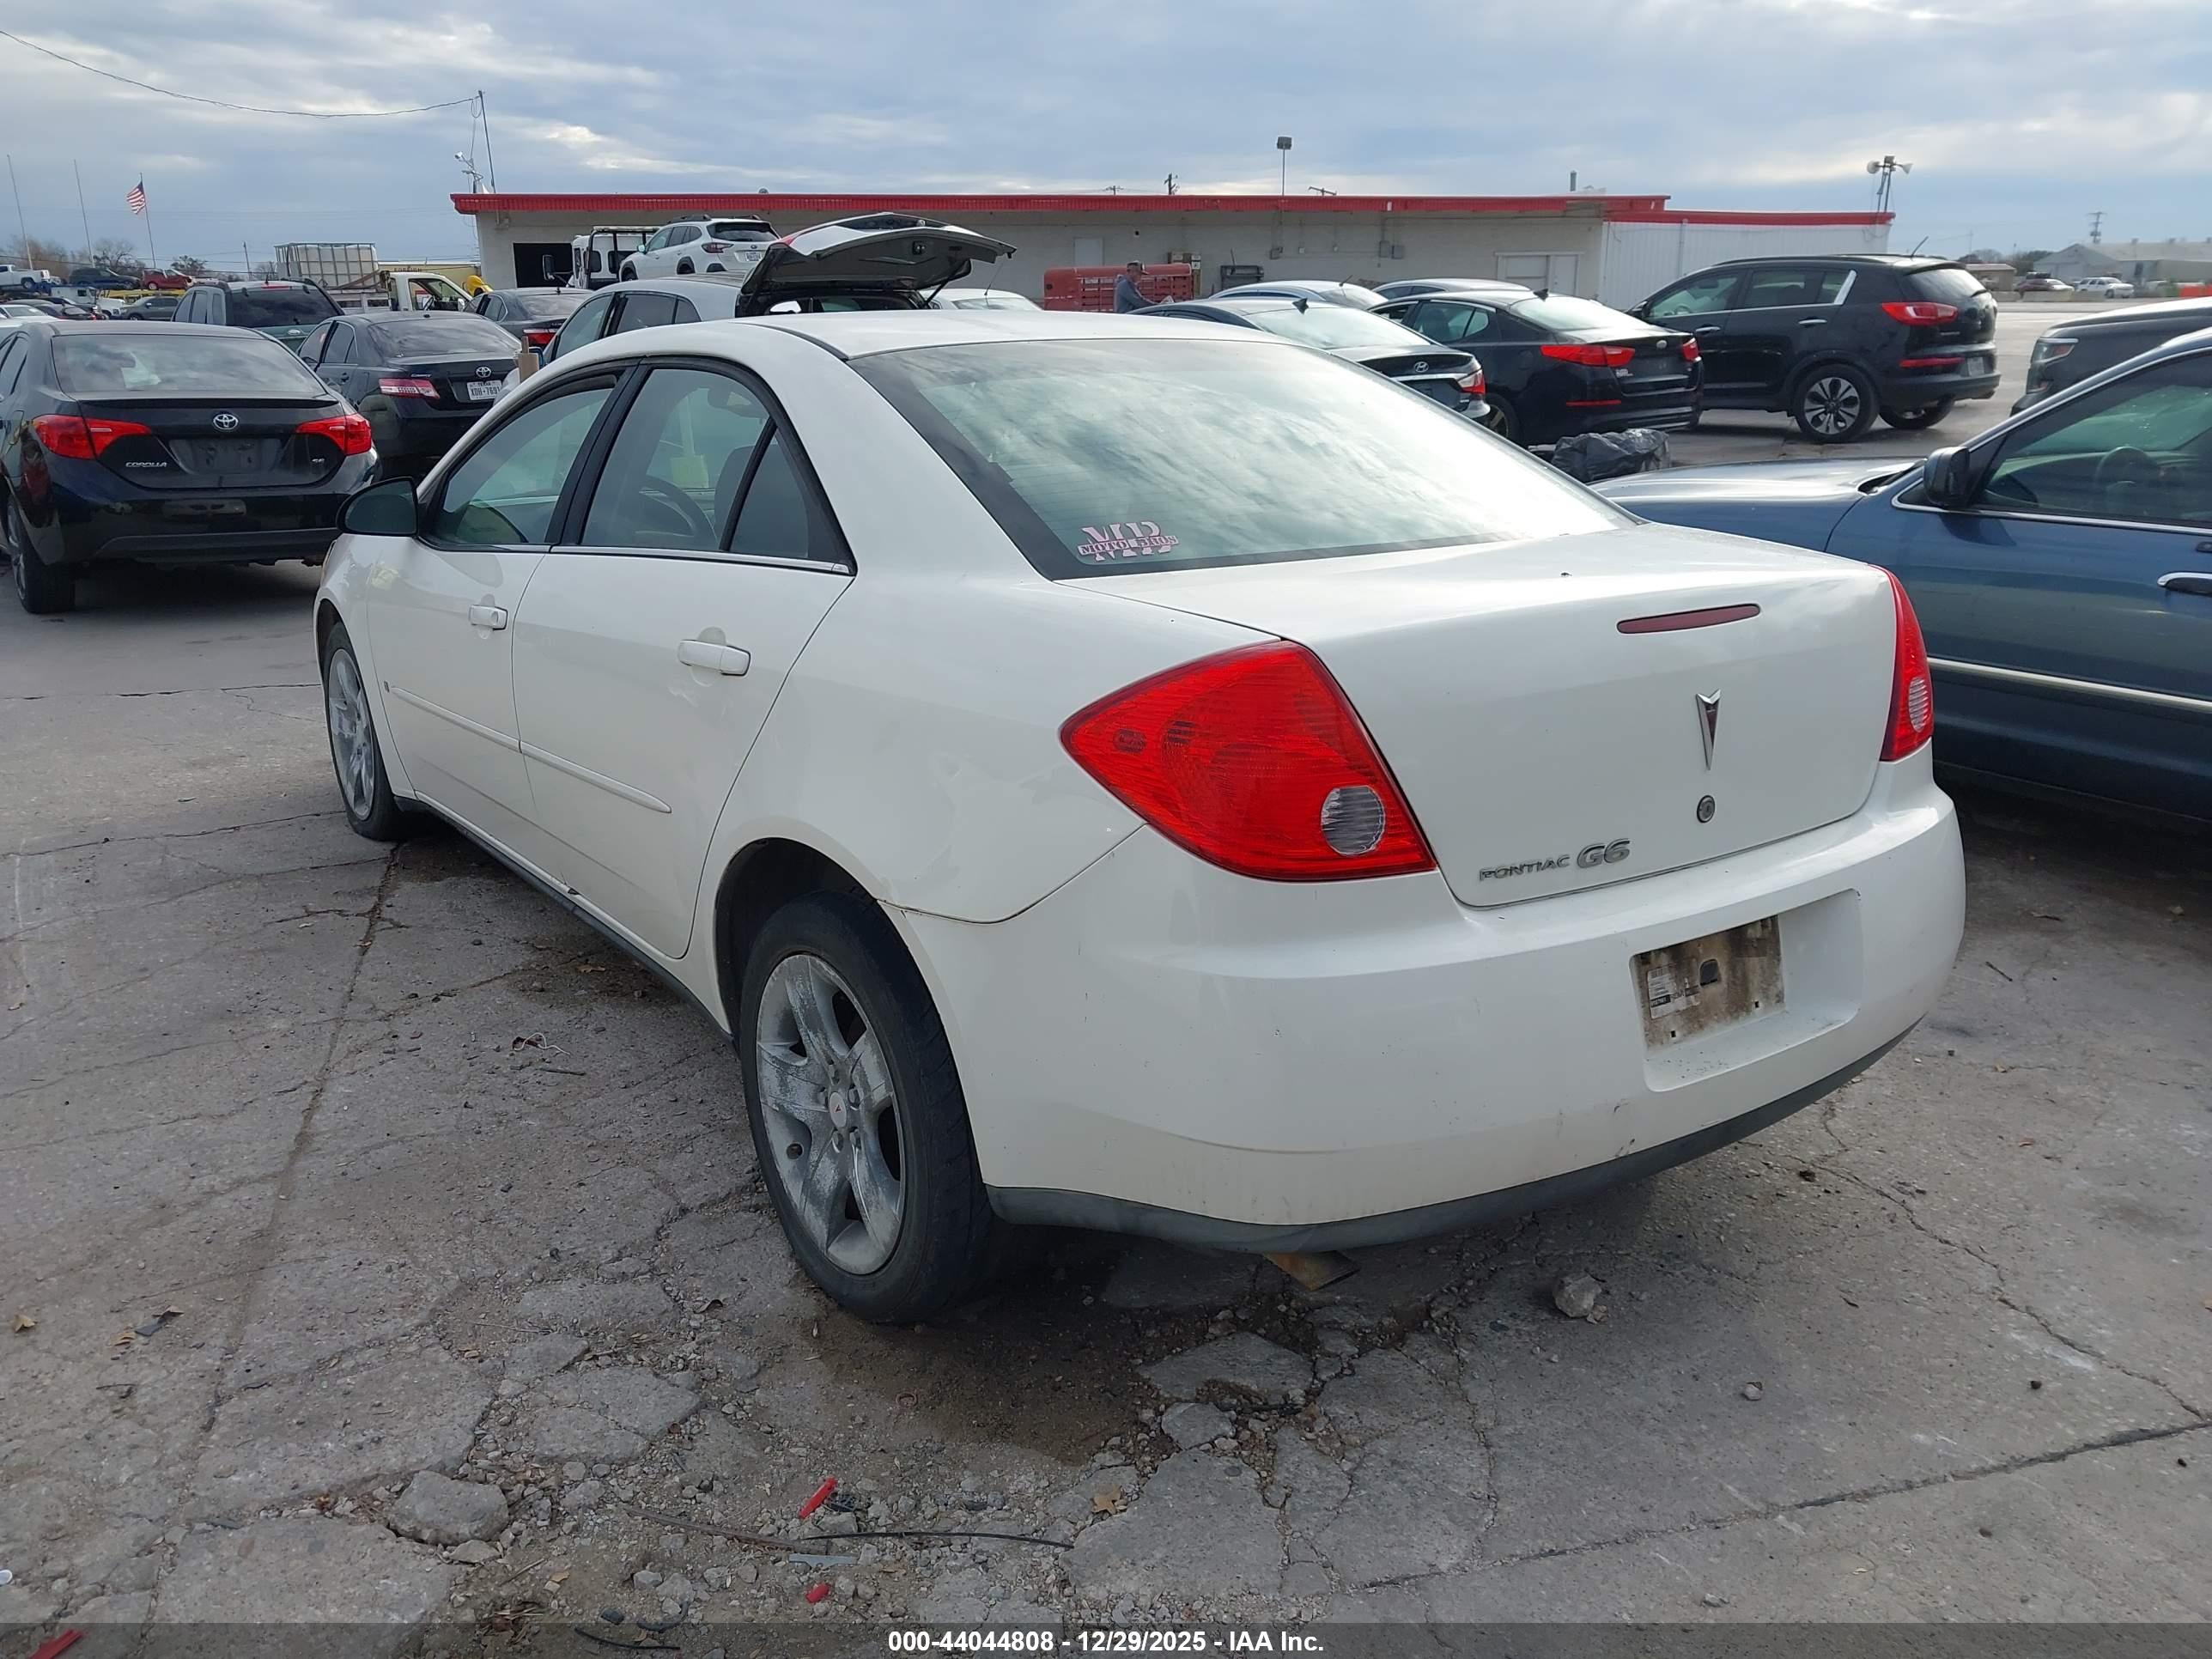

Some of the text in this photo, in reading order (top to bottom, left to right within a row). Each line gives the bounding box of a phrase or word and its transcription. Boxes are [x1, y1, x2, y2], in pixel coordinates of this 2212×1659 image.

[1080, 540, 1127, 555] MOTO
[1479, 837, 1632, 881] PONTIAC G6
